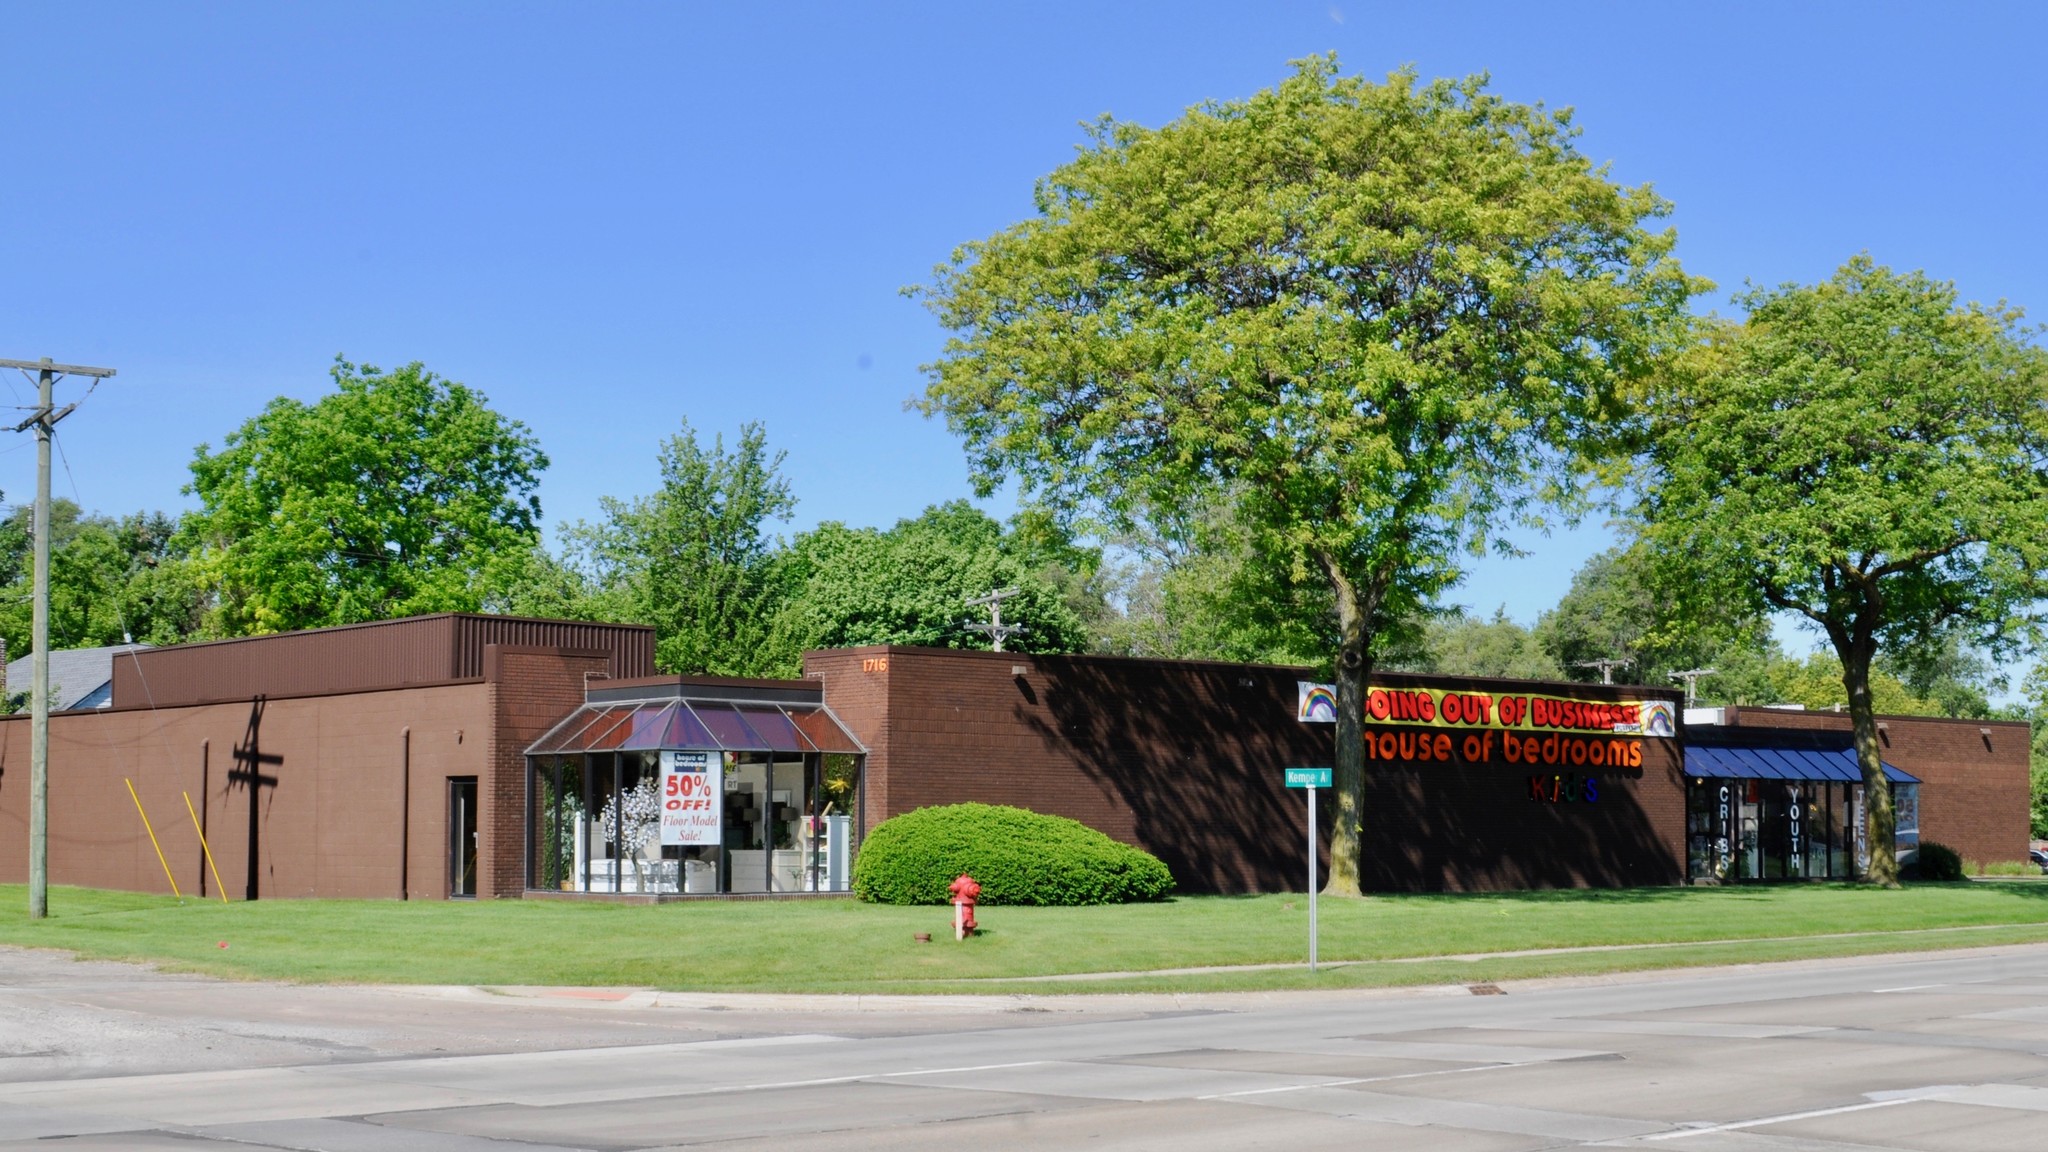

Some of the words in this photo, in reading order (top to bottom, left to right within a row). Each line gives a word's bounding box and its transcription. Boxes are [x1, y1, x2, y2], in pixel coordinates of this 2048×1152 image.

[863, 657, 887, 672] 1716
[1440, 692, 1494, 725] OUT
[1499, 696, 1528, 726] OF
[1463, 729, 1494, 762] of
[1503, 730, 1643, 768] bedrooms
[666, 775, 711, 797] 50%
[1288, 771, 1316, 785] Kempe
[1531, 773, 1599, 803] Kids
[665, 799, 712, 811] OFF!
[663, 815, 689, 827] Floor
[690, 815, 719, 827] Model
[1719, 786, 1729, 871] CRIBS
[1789, 788, 1800, 869] YOUTH
[1857, 789, 1866, 868] TEENS
[678, 829, 702, 841] Sale!
